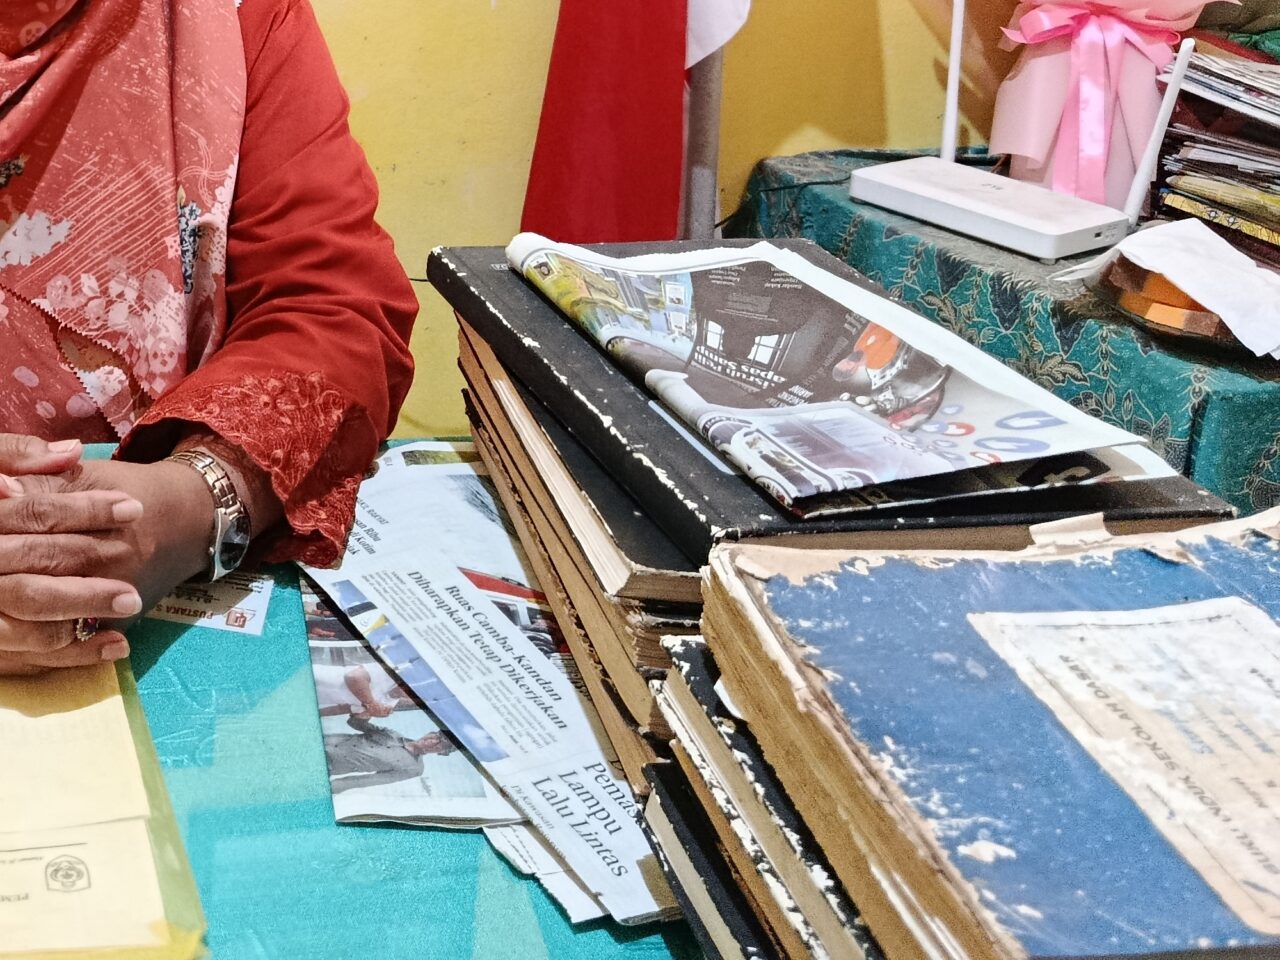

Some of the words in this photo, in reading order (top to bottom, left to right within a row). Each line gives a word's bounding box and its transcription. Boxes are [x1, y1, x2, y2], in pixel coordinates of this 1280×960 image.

[166, 606, 214, 620] PUSTAKA
[445, 585, 475, 612] Ruas
[472, 612, 562, 701] Camba-Kandan
[407, 570, 471, 631] Diharapkan
[469, 630, 502, 664] Tetap
[499, 663, 568, 730] Dikerjakan
[1058, 655, 1110, 701] DASAR
[1106, 701, 1177, 772] SEKOLAH
[532, 776, 575, 818] Lalu
[571, 819, 629, 877] Lintas
[558, 770, 623, 836] Lampu
